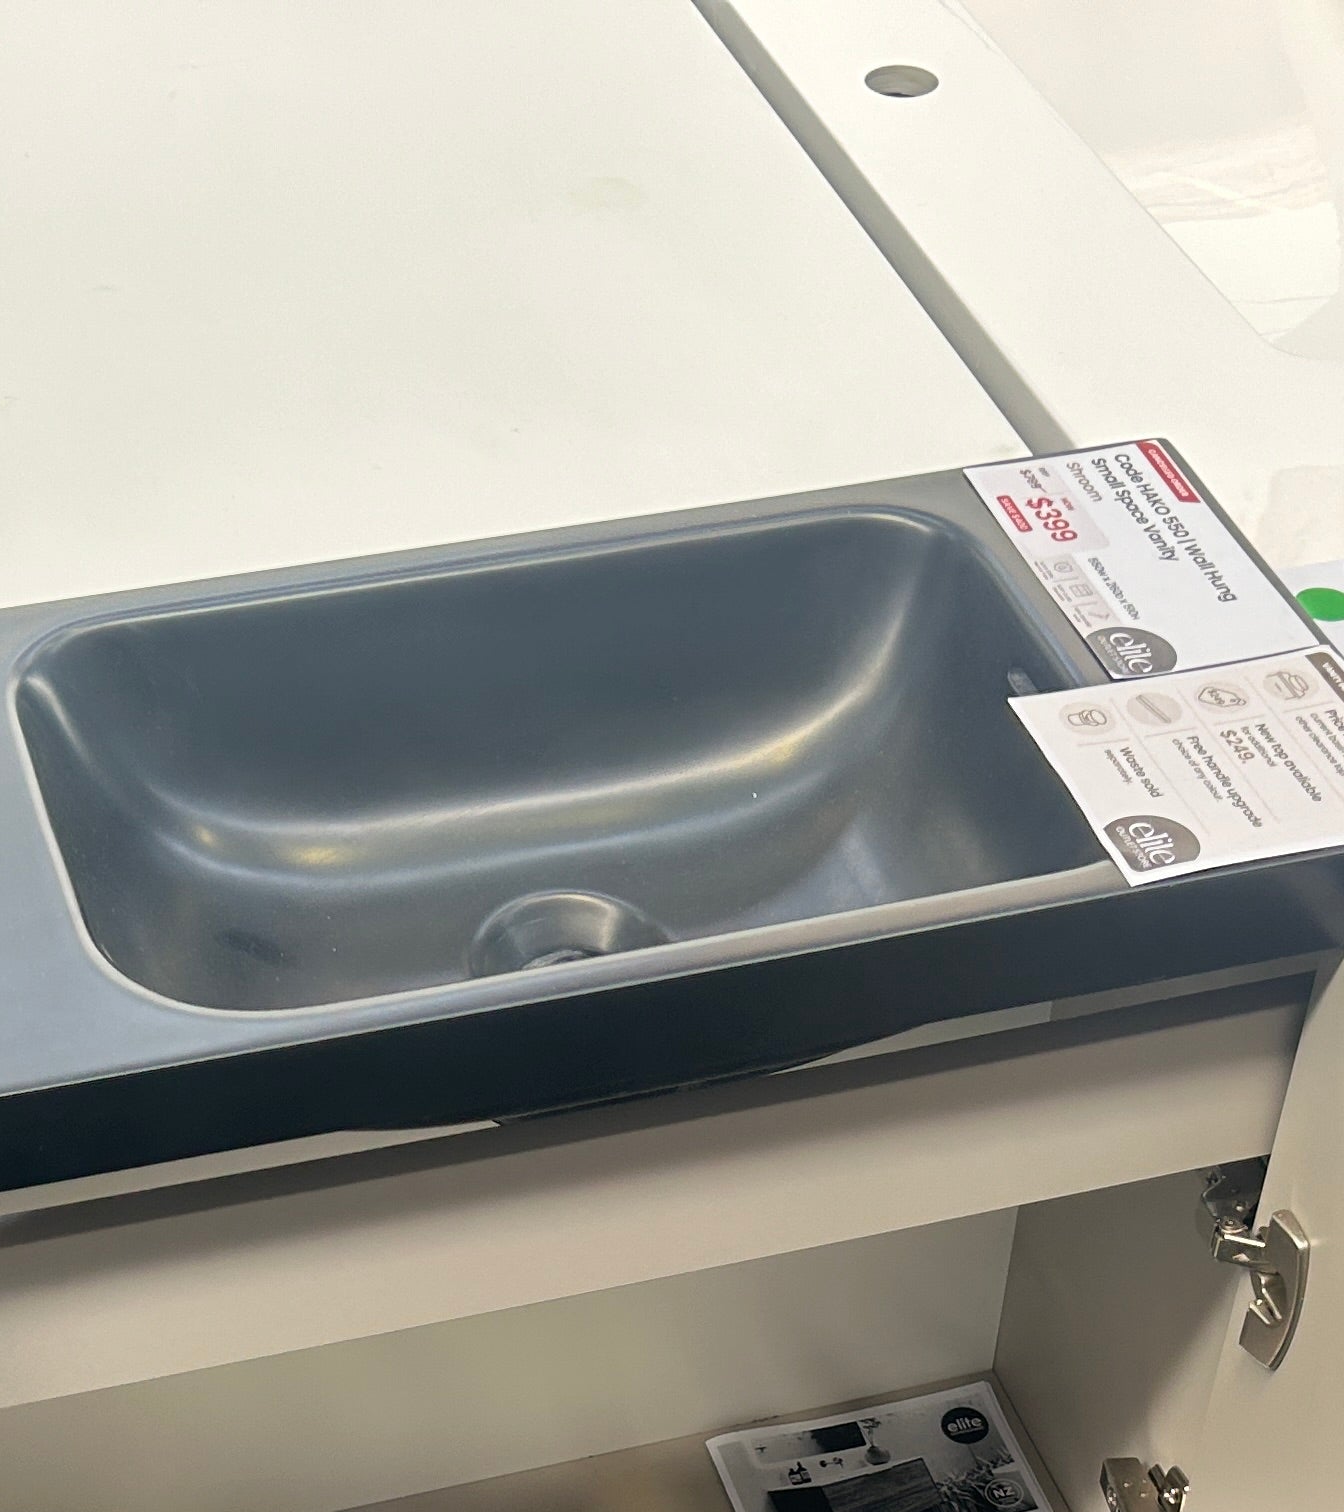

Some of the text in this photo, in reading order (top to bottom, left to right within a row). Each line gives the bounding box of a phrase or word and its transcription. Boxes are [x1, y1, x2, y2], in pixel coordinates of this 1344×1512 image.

[1066, 462, 1102, 502] Shroom
[1001, 498, 1016, 514] SAVE
[1026, 497, 1078, 542] $399
[1091, 458, 1179, 561] Small Space Vanity
[1114, 454, 1143, 483] Code
[1136, 484, 1171, 515] HAKO
[1162, 516, 1189, 537] 550
[1184, 544, 1215, 570] Wall
[1204, 570, 1237, 602] Hung
[1110, 633, 1153, 672] elite
[1255, 723, 1277, 743] New
[1271, 744, 1289, 759] top
[1295, 716, 1312, 732] other
[1310, 713, 1333, 735] current
[1220, 730, 1255, 764] $249.
[1120, 747, 1164, 798] Waste sold
[1187, 736, 1262, 827] Free handle upgrade
[1129, 822, 1175, 864] elite
[947, 1417, 982, 1432] elite
[993, 1486, 1015, 1498] NZ
